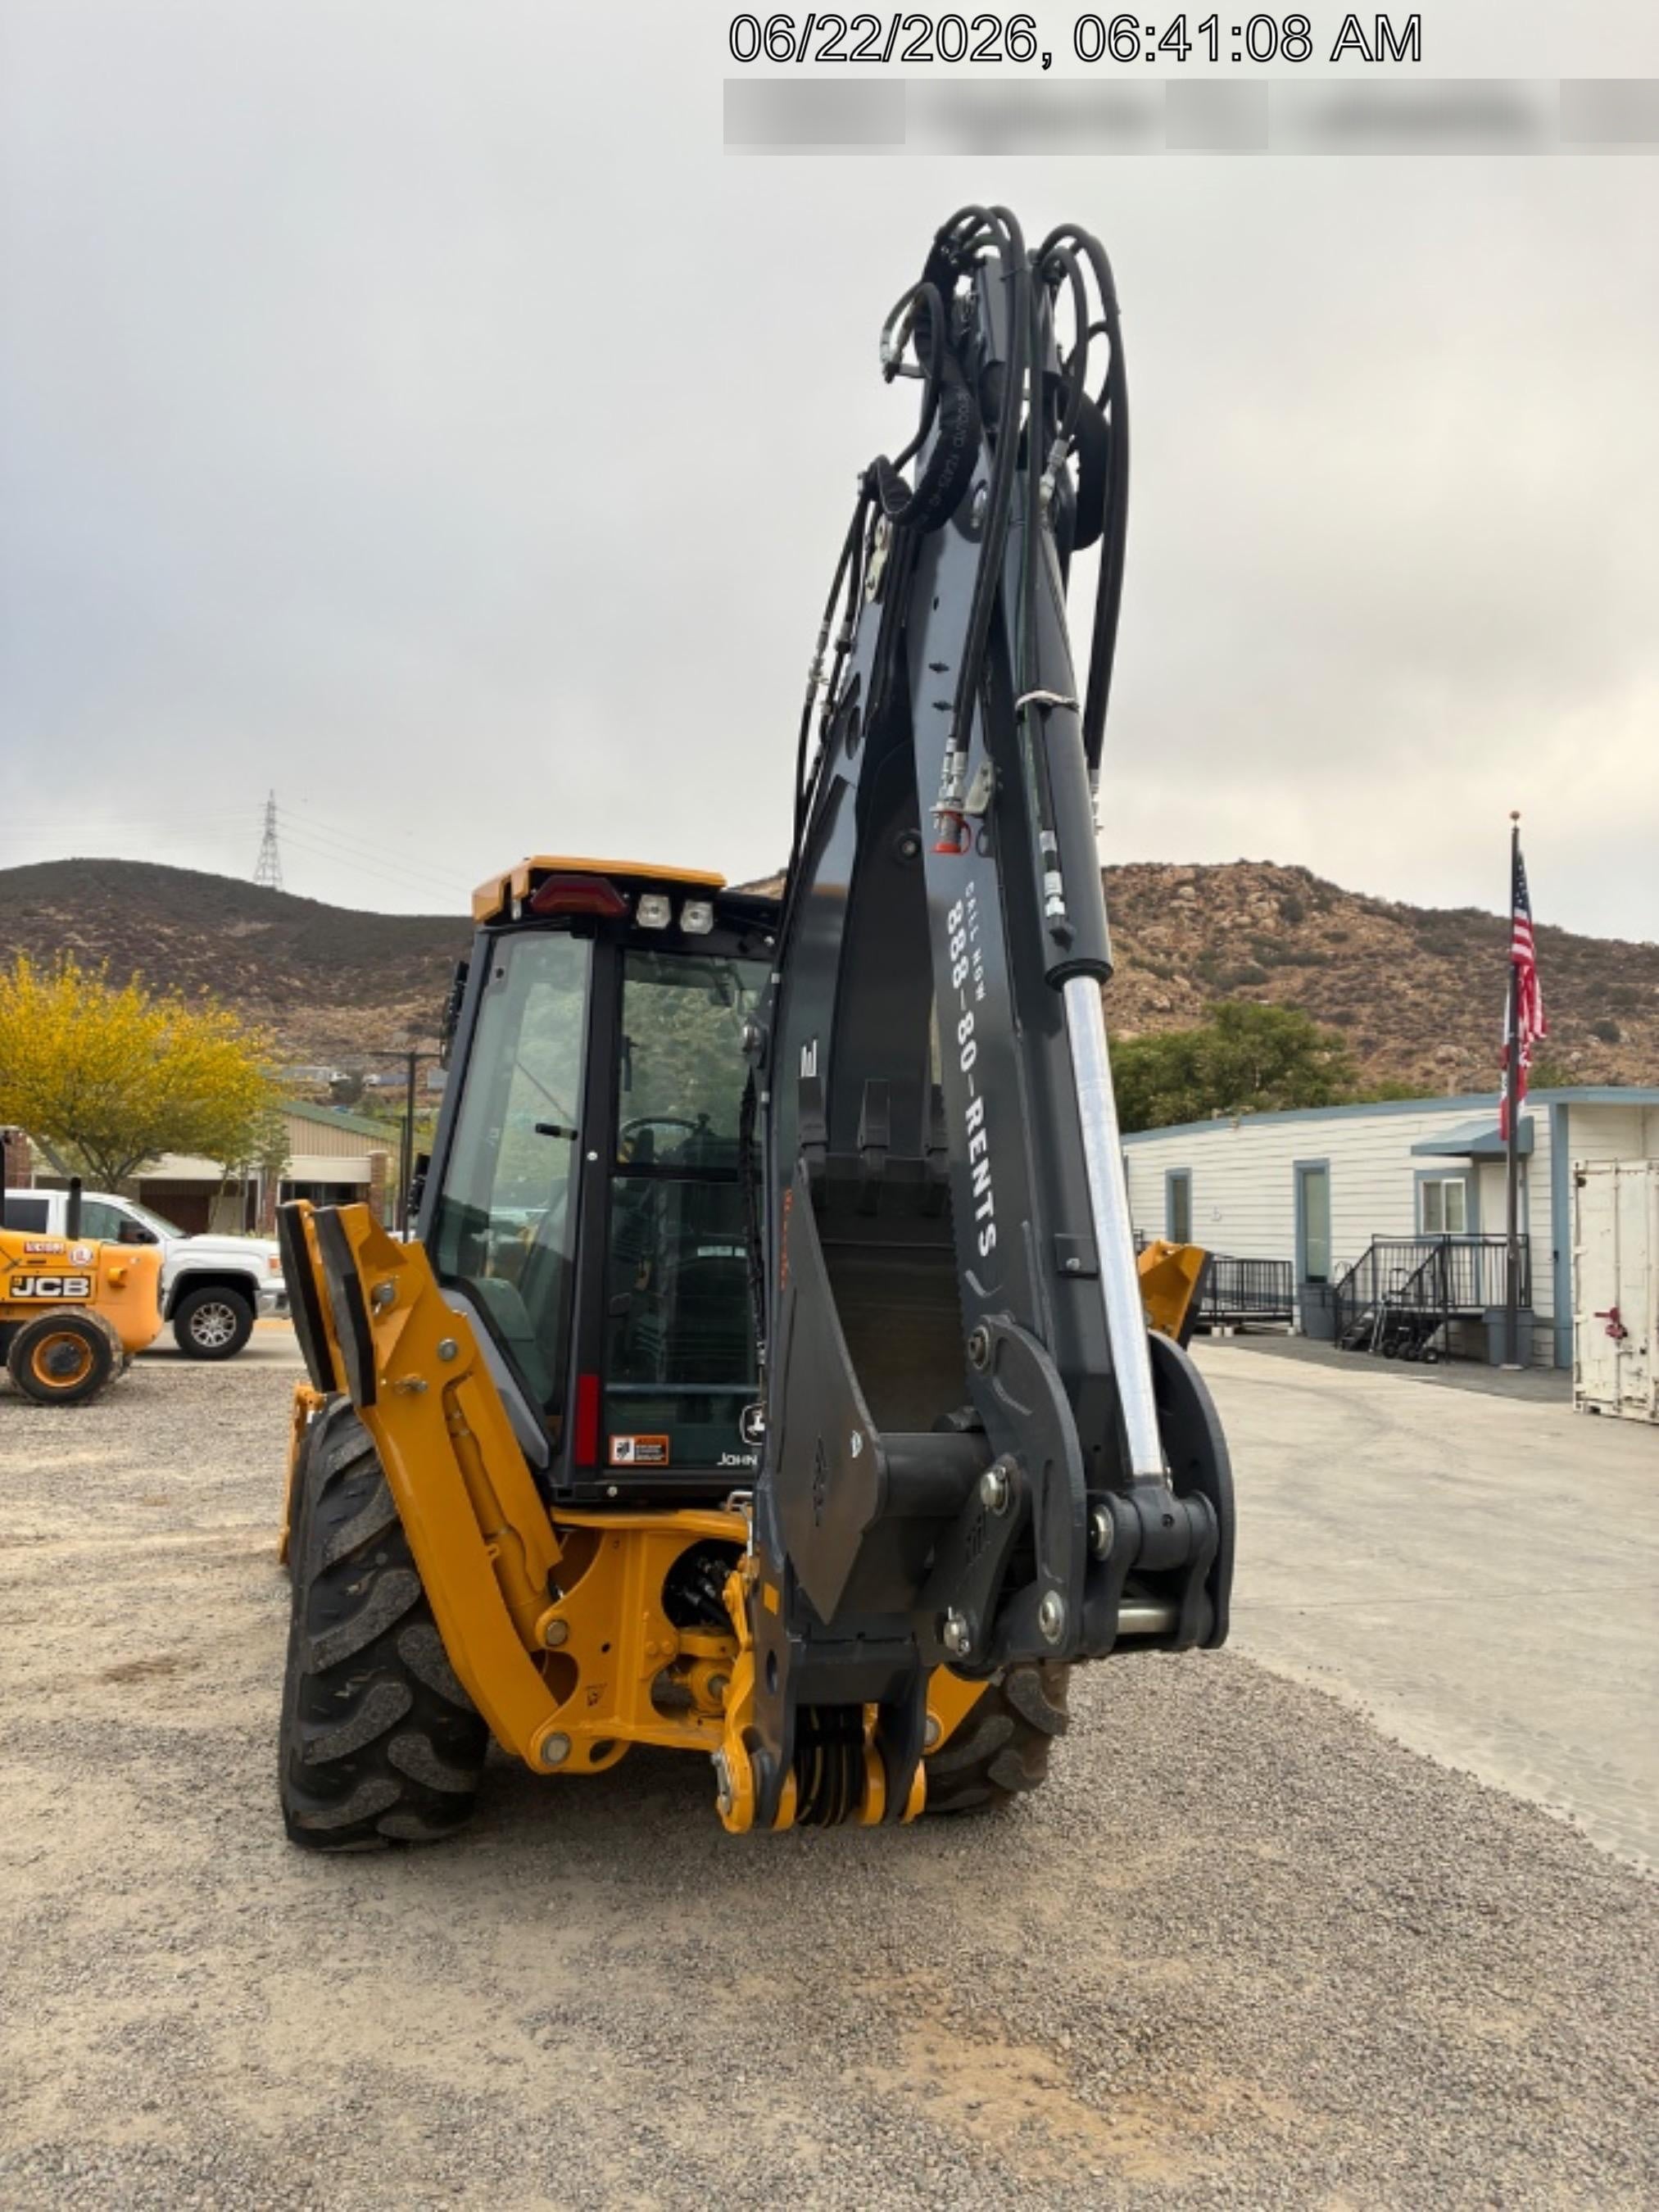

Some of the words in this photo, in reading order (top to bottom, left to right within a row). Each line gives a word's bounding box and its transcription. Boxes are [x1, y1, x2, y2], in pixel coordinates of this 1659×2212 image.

[965, 881, 979, 942] CALL
[972, 947, 986, 1001] NOW
[947, 899, 997, 1258] 888-80-RENTS
[11, 1276, 89, 1297] JCB
[716, 1452, 758, 1466] JOHN
